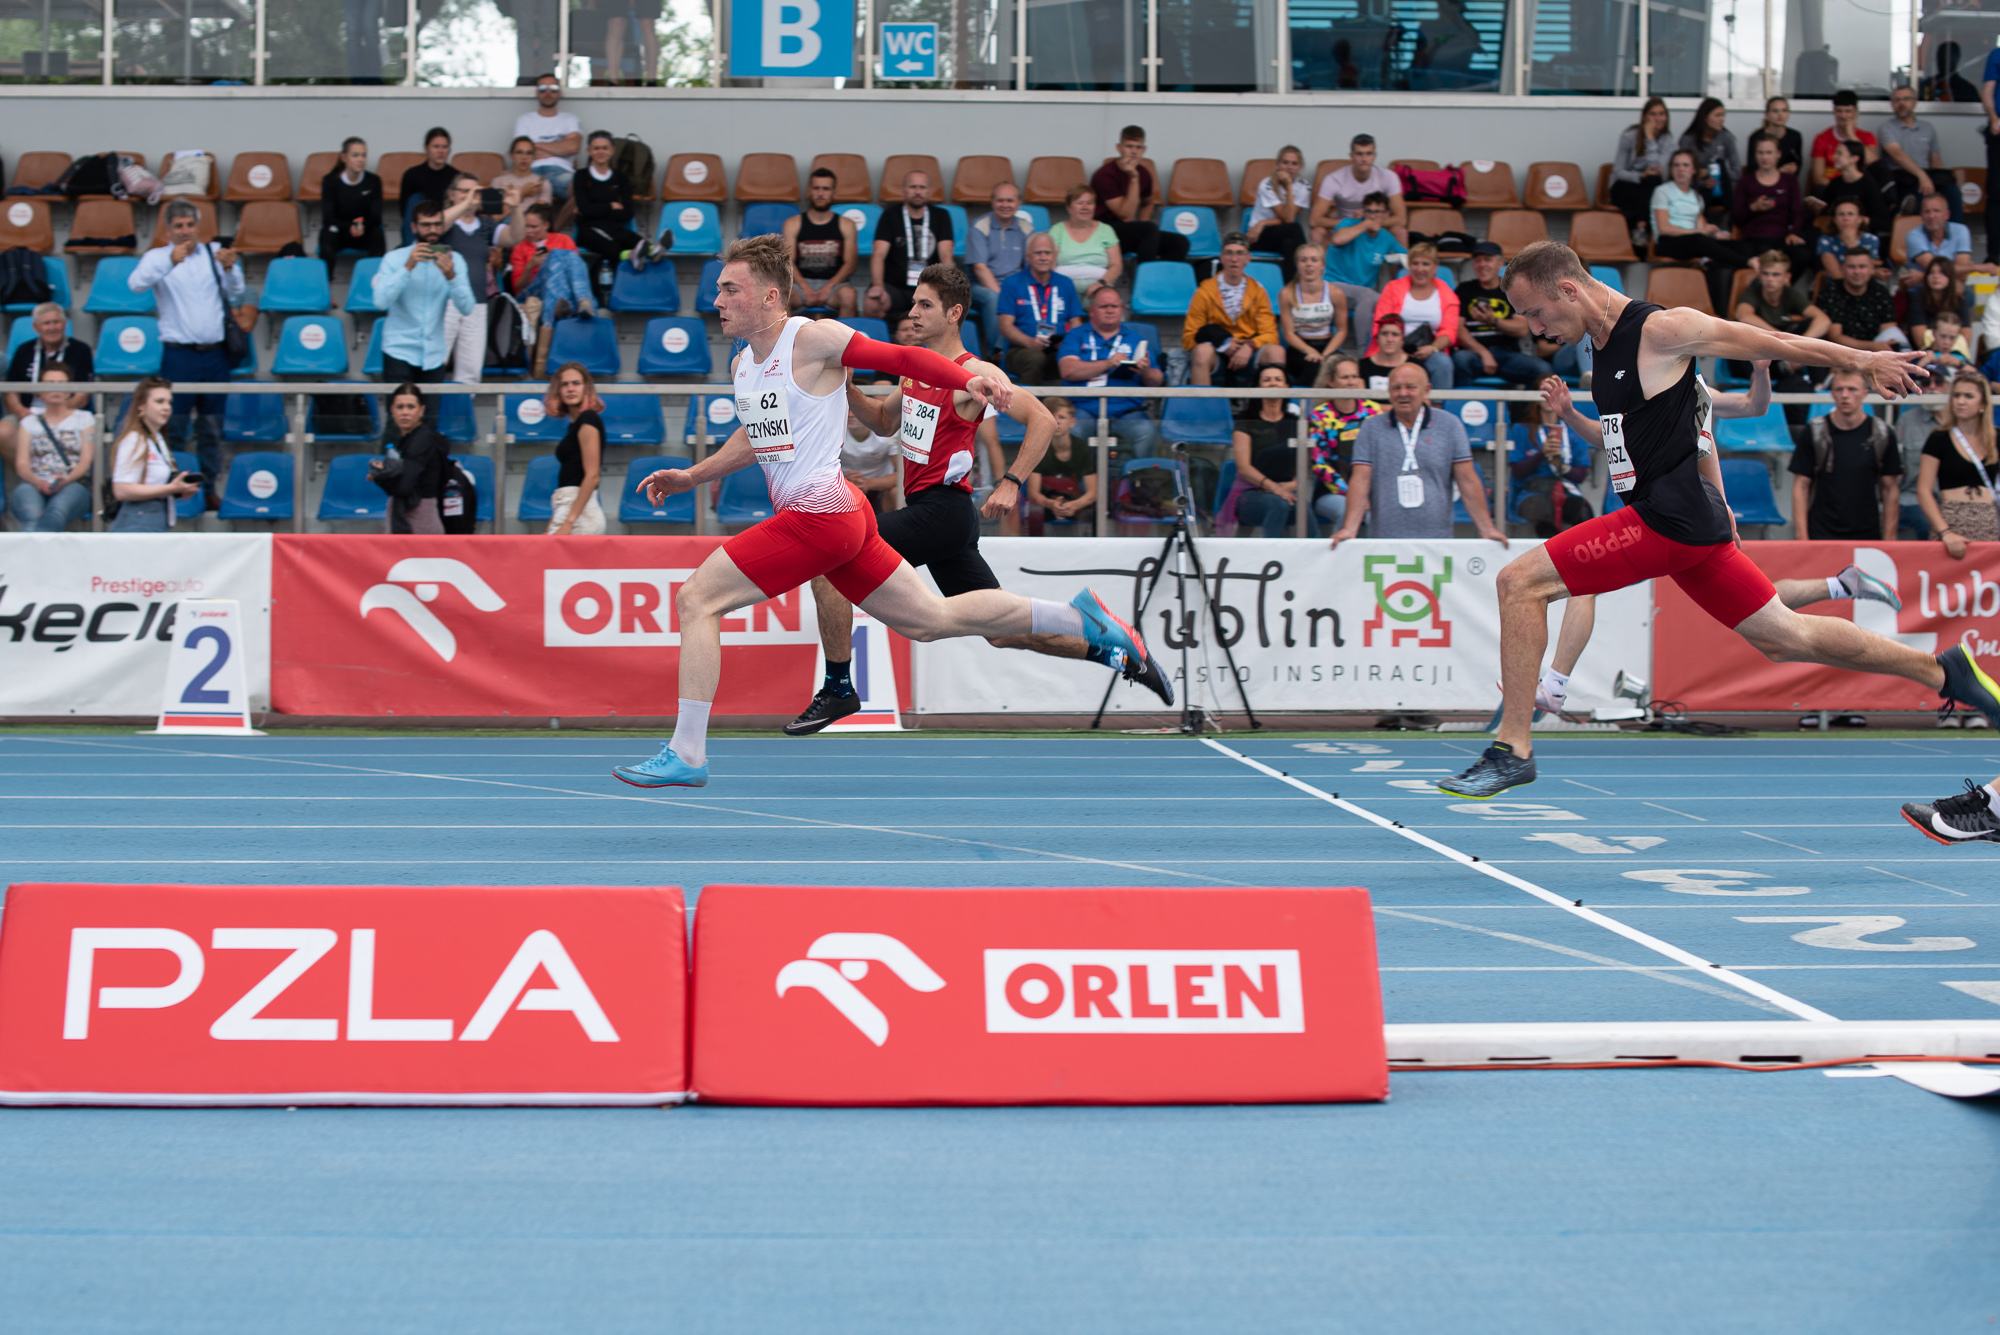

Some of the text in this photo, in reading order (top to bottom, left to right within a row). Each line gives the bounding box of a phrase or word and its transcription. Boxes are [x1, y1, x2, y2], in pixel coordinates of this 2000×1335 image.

[761, 0, 822, 67] B
[885, 32, 933, 55] WC
[1615, 370, 1626, 380] 4F
[760, 392, 778, 410] 62
[916, 403, 935, 422] 284
[180, 625, 231, 704] 2
[1173, 665, 1452, 685] ASTO INSPIRACJI
[1620, 869, 1812, 896] 3
[1731, 915, 1978, 951] 2
[63, 927, 621, 1042] PZLA
[1005, 963, 1280, 1019] ORLEN
